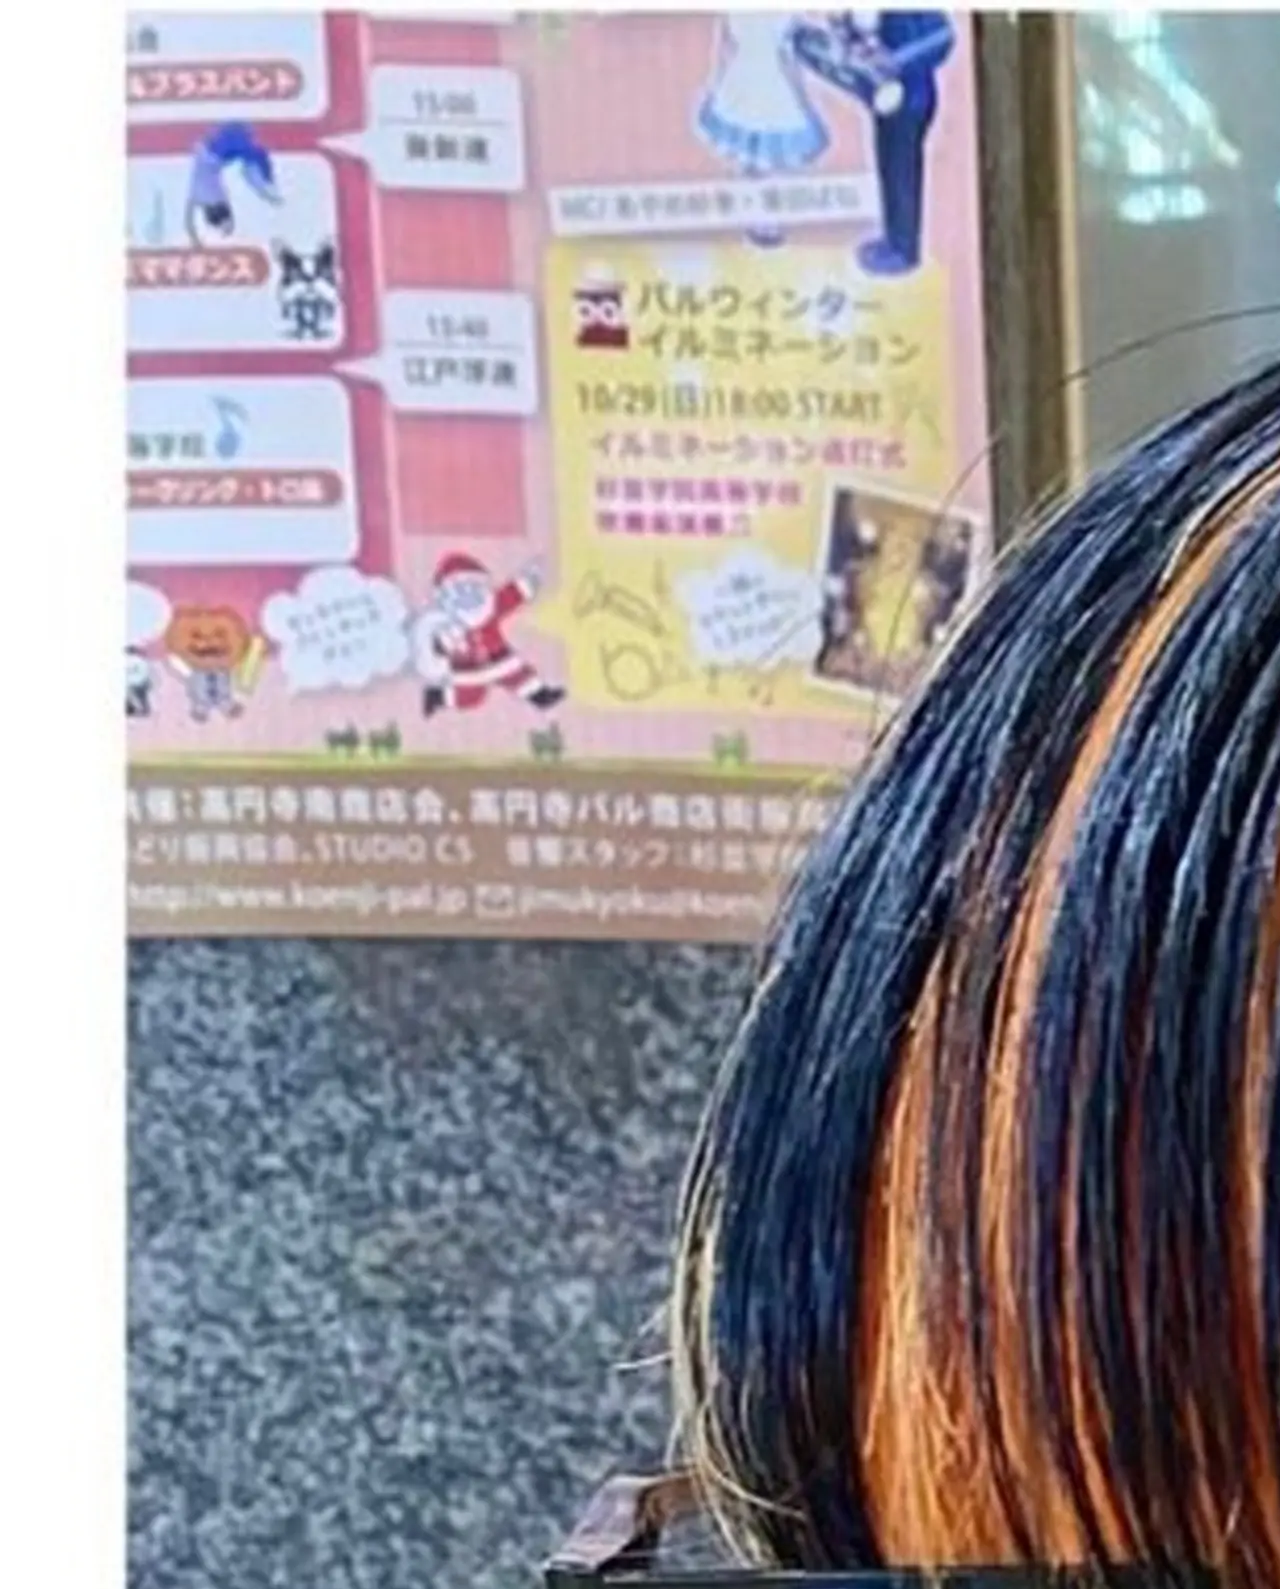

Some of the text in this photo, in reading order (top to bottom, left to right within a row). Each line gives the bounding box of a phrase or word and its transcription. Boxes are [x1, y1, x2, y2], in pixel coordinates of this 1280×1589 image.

[637, 281, 884, 320] パルウィンター
[638, 324, 922, 366] イルミネーション
